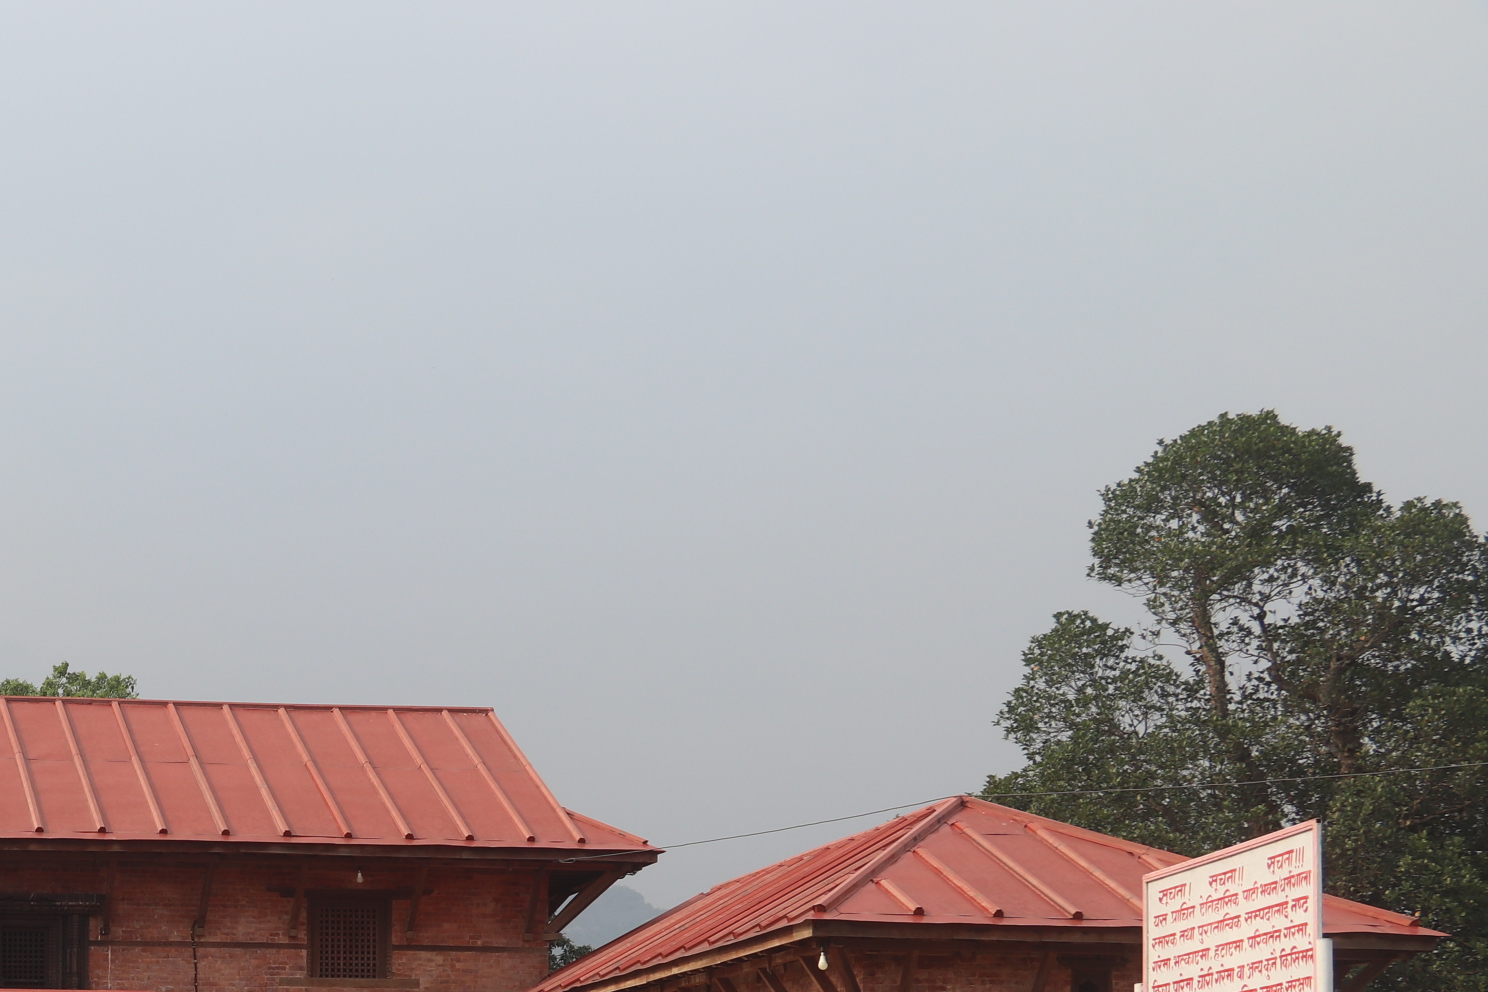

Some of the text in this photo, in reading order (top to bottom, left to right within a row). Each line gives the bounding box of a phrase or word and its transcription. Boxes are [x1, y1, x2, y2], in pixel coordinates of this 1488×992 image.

[1153, 913, 1168, 927] यस
[1171, 901, 1195, 924] प्राचिन
[1242, 880, 1259, 902] पाटी
[1152, 932, 1177, 952] स्मारक
[1179, 926, 1195, 944] तथा
[1247, 925, 1282, 953] परिवर्तन
[1197, 966, 1214, 990] चोरी
[1215, 963, 1235, 986] गरेमा
[1237, 964, 1245, 980] वा
[1247, 960, 1263, 979] अन्य
[1263, 948, 1277, 980] कुनै
[1279, 941, 1314, 970] किसिमले
